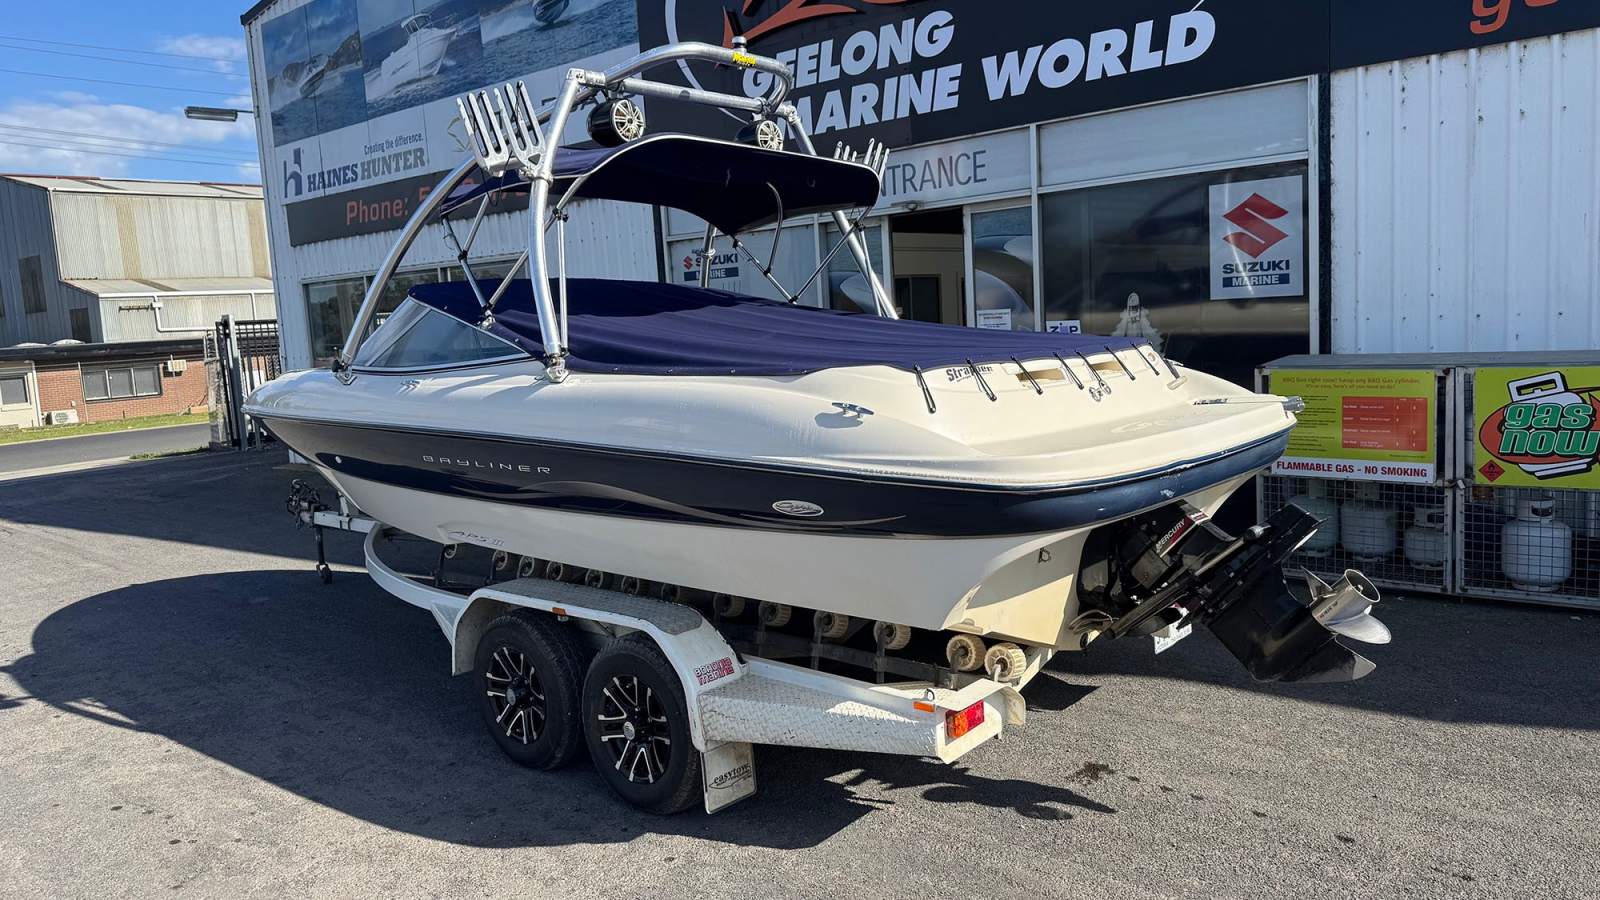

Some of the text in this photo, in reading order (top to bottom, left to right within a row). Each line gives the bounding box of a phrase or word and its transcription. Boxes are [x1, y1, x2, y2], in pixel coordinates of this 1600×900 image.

[742, 10, 955, 98] GEELONG
[981, 10, 1216, 101] WORLD
[364, 142, 385, 155] Creating
[385, 139, 394, 149] the
[307, 147, 426, 193] HAINES HUNTER
[346, 197, 409, 225] Phone:
[695, 253, 739, 267] SZUKI
[1222, 259, 1290, 274] SUZUKI
[1231, 274, 1280, 287] MARINE
[1504, 402, 1595, 429] gas
[1499, 429, 1600, 455] now
[422, 455, 551, 474] BAYLINER
[1277, 461, 1333, 472] FLAMMABLE
[1335, 463, 1355, 474] GAS
[1364, 466, 1378, 475] NO
[1381, 467, 1427, 478] SMOKING
[1155, 518, 1185, 553] MERCURY
